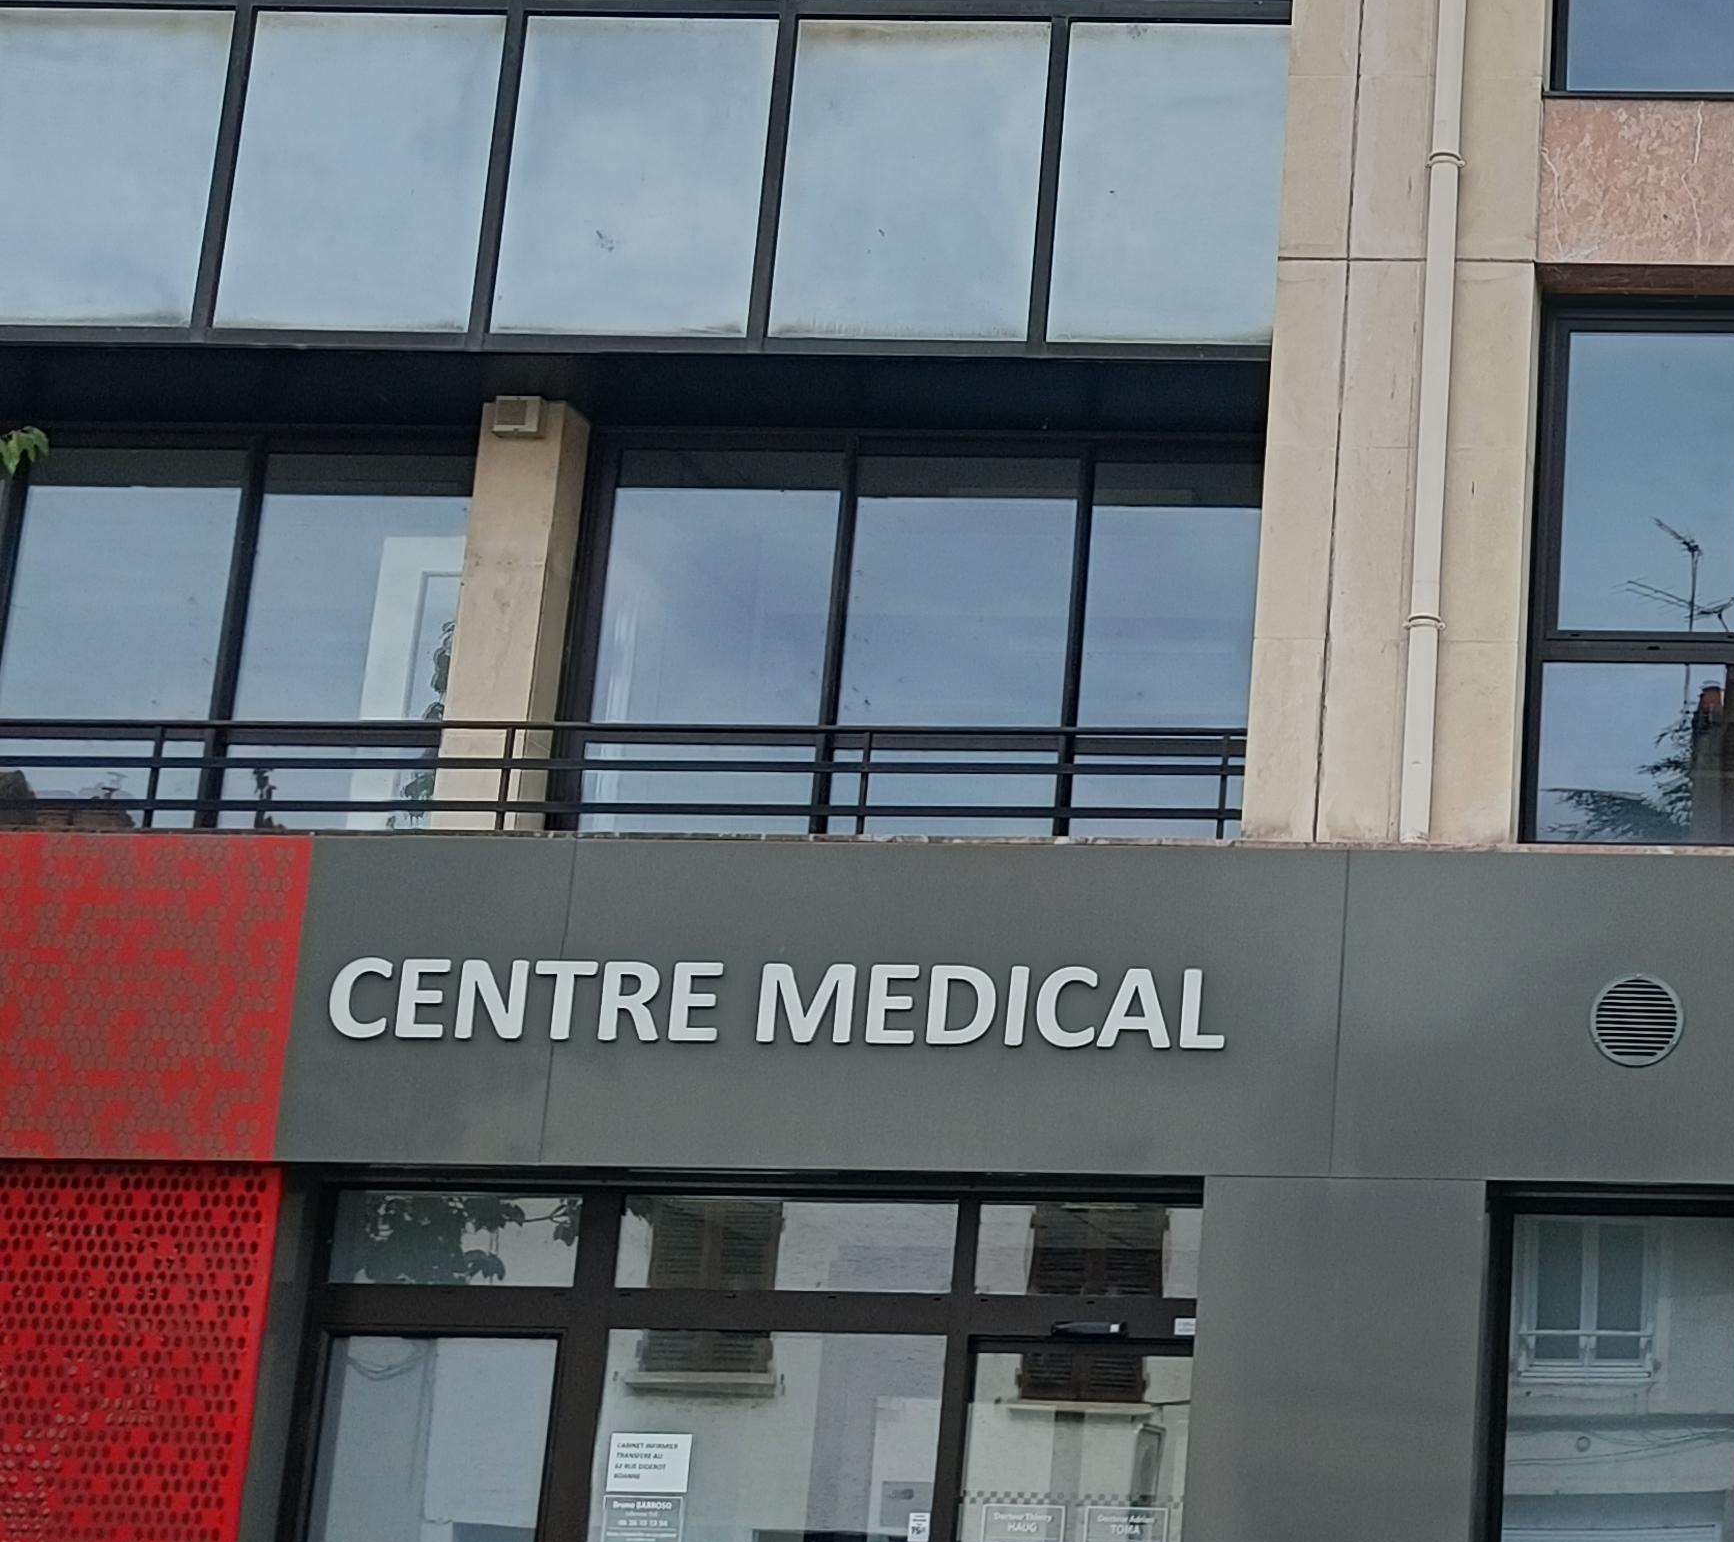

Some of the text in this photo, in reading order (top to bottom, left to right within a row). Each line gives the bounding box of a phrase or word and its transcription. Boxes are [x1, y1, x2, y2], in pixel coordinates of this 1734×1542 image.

[329, 957, 1226, 1049] CENTRE MEDICAL
[1110, 1524, 1141, 1535] TOMA
